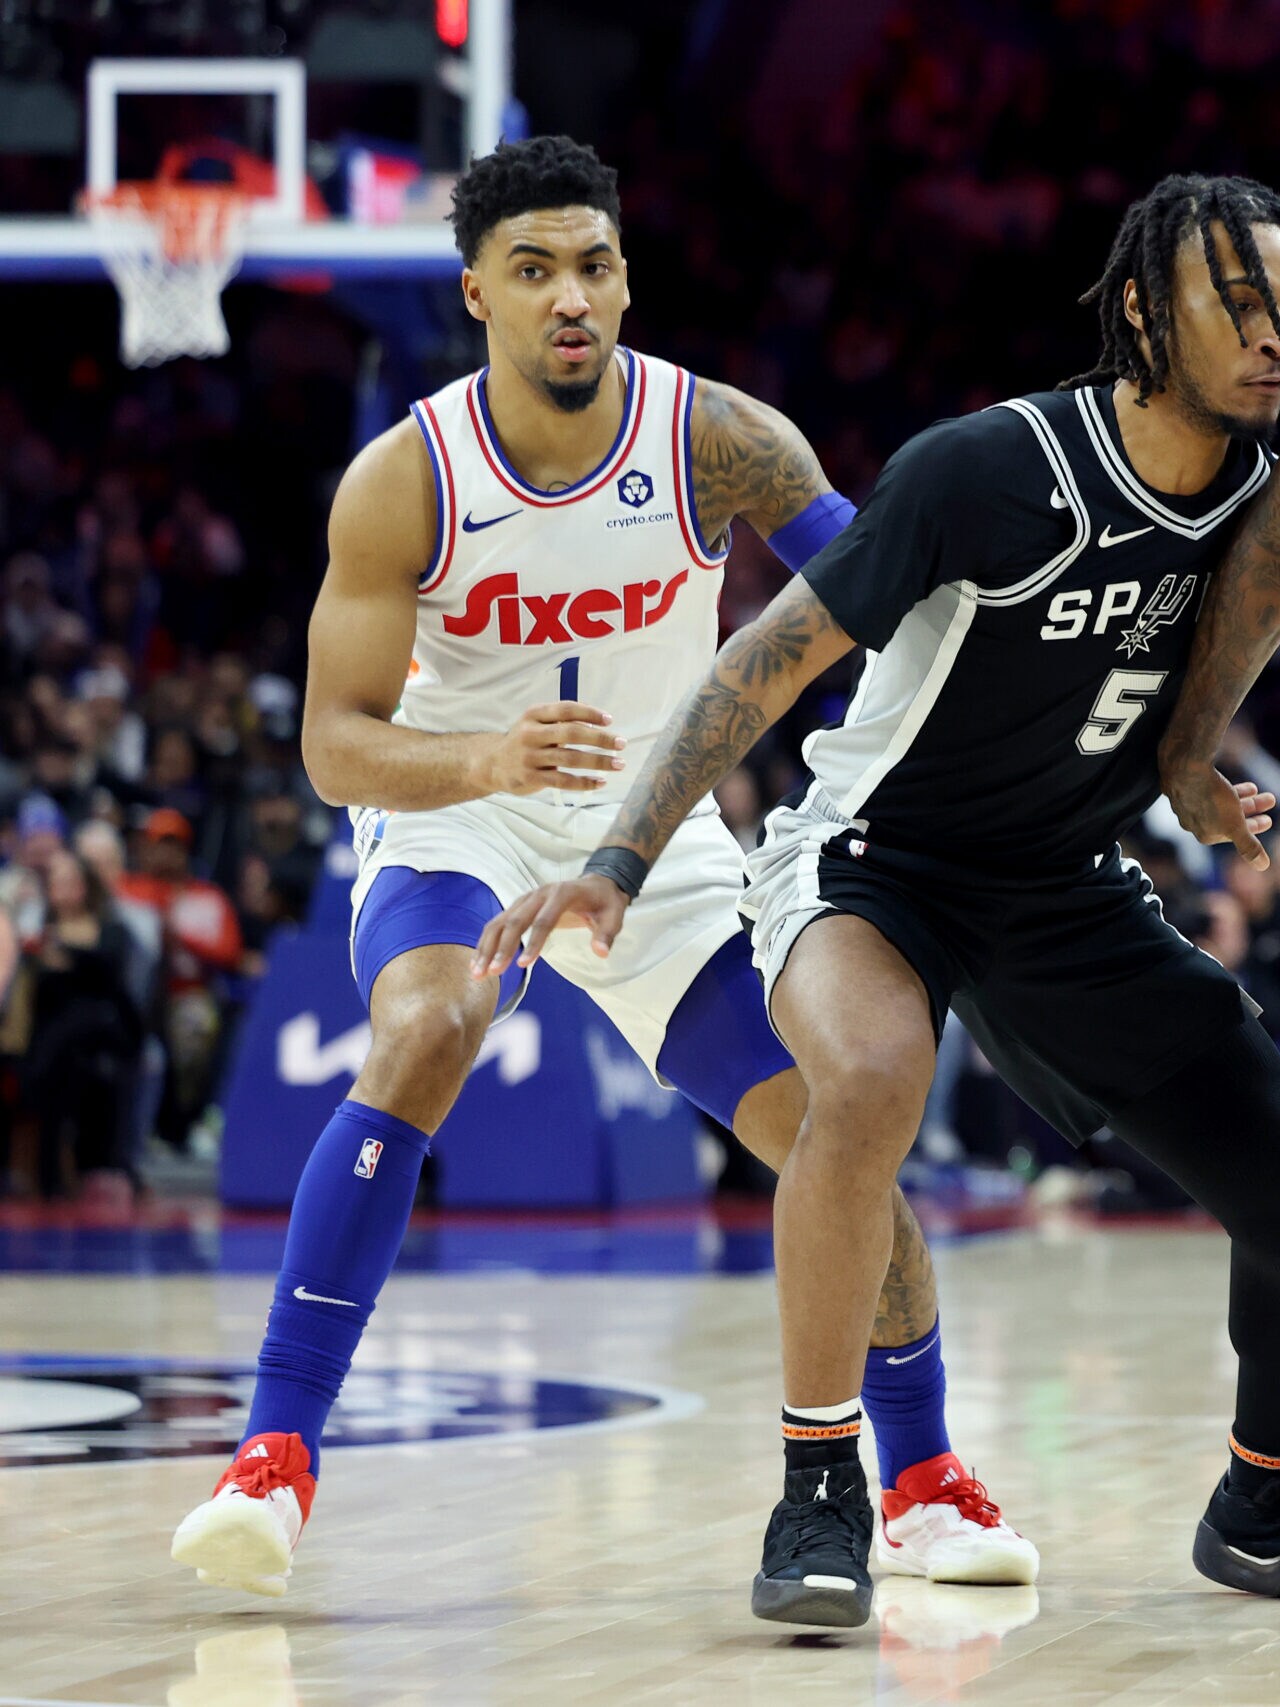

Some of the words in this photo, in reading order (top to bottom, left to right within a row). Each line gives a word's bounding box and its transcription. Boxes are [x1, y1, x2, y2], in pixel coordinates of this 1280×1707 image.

[606, 512, 674, 528] crypto.com
[442, 567, 689, 646] Sixers
[553, 656, 580, 703] 1
[1075, 668, 1169, 756] 5
